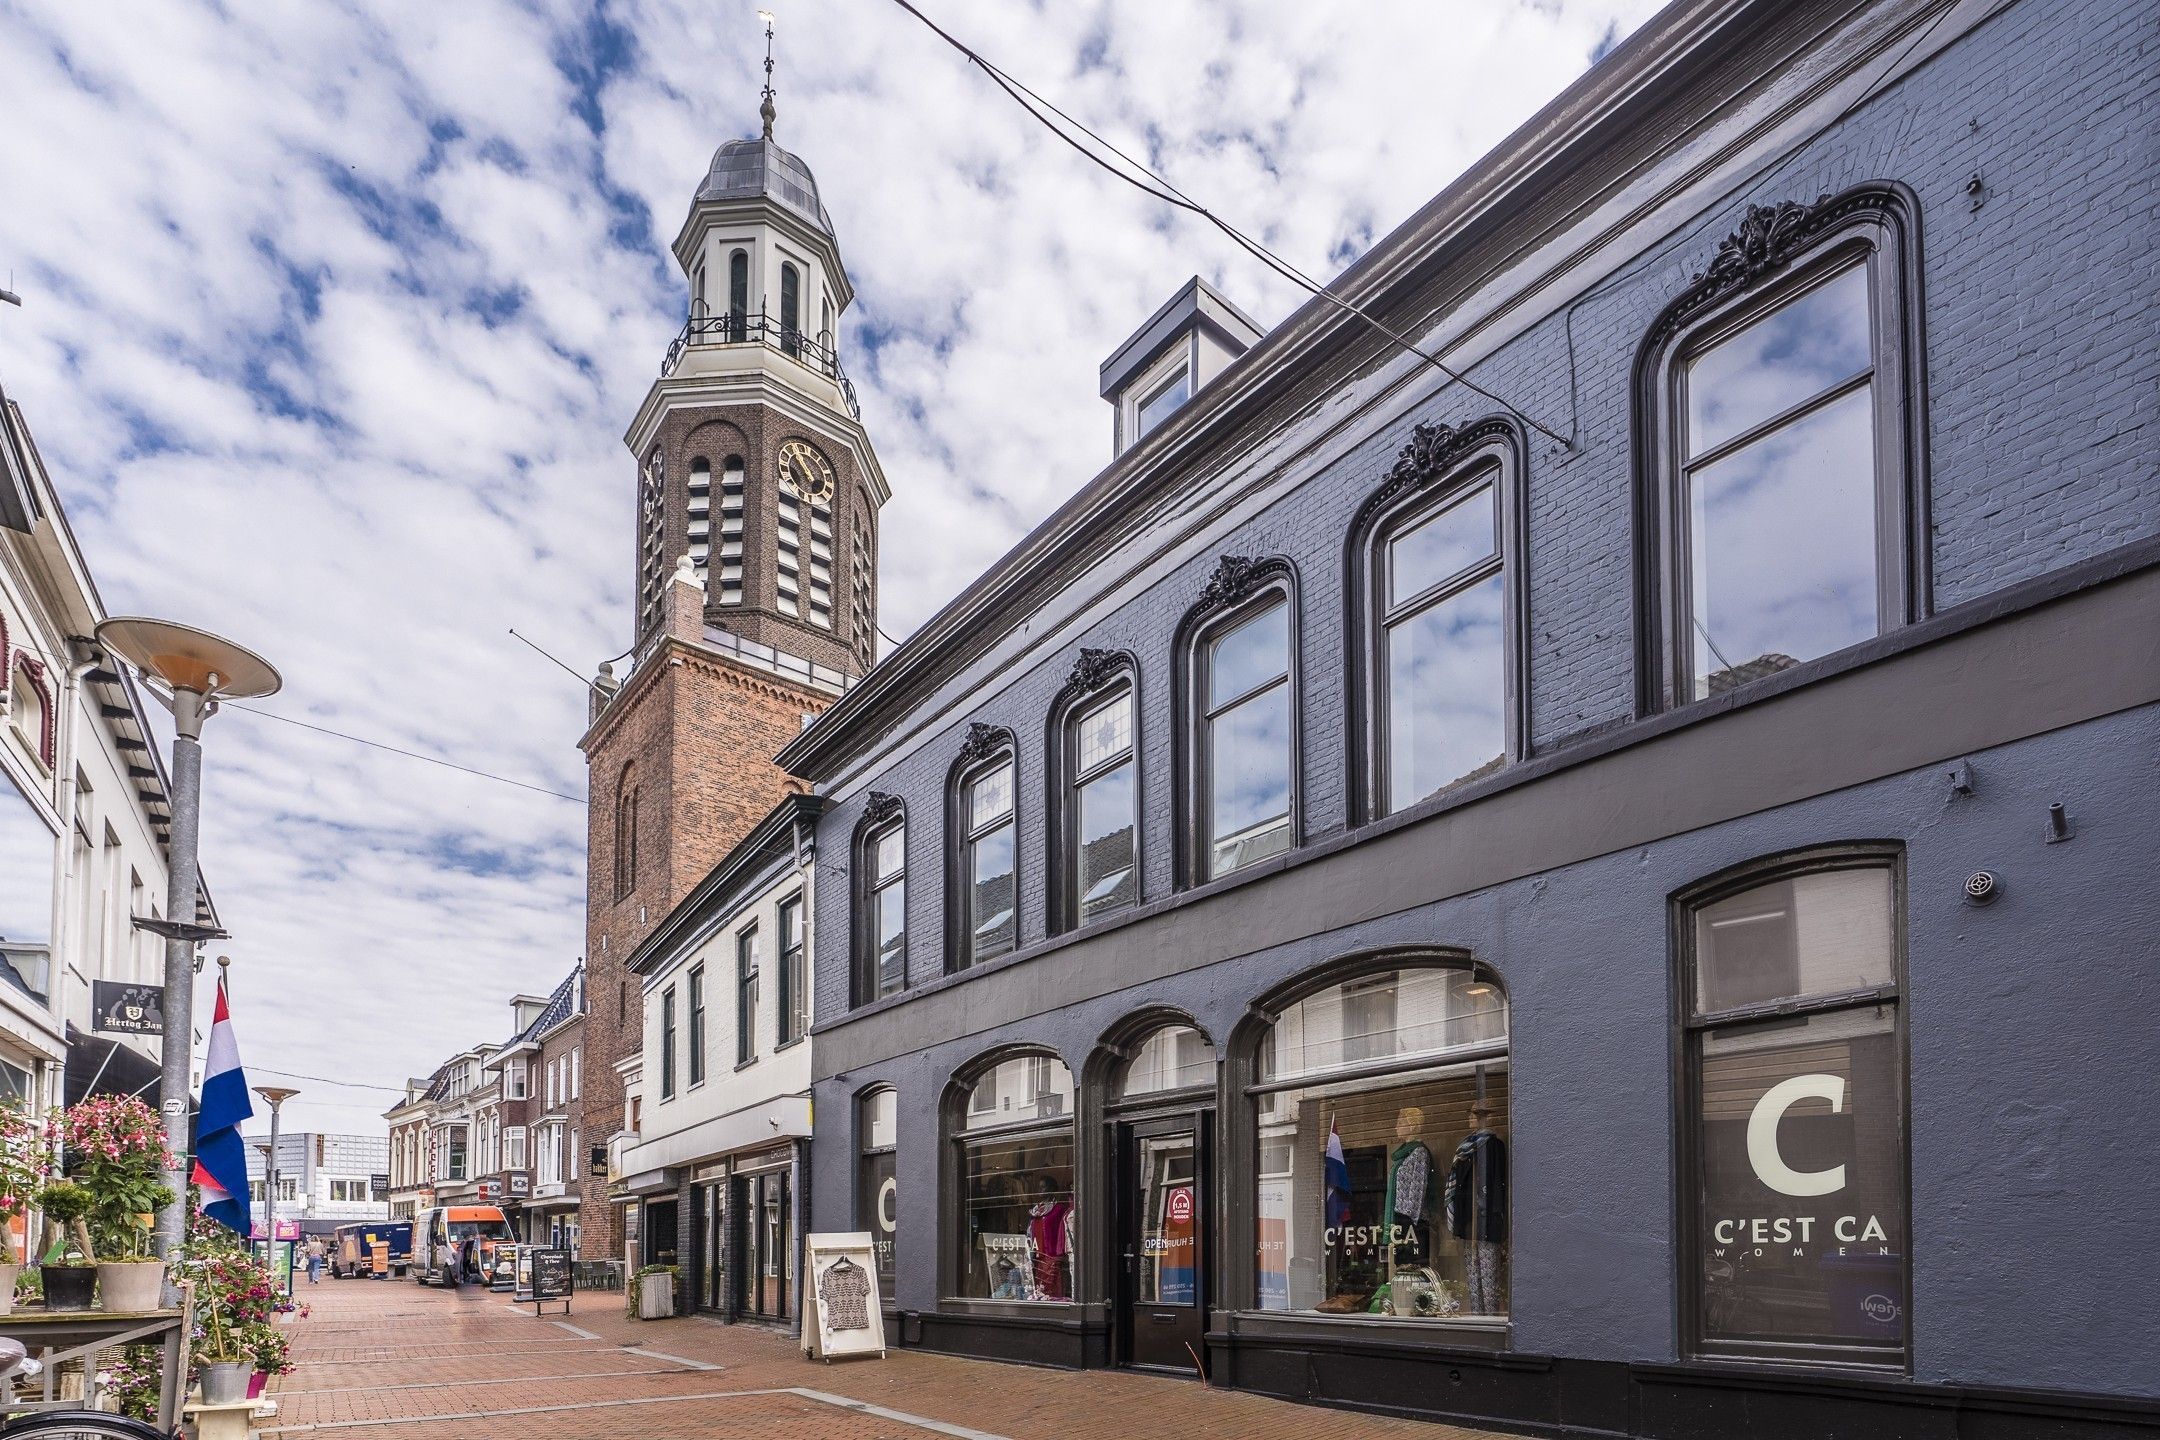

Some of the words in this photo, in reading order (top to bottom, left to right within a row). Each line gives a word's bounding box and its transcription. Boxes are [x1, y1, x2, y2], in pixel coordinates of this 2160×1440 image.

[105, 1017, 141, 1030] Hertog
[143, 1020, 162, 1030] Jan
[1746, 1073, 1846, 1197] C
[1324, 1225, 1382, 1246] C'EST
[1390, 1224, 1418, 1244] CA
[1714, 1217, 1815, 1244] C'EST
[1834, 1215, 1888, 1242] CA
[992, 1237, 1020, 1251] C'EST
[1145, 1239, 1168, 1249] OPEN
[1324, 1248, 1419, 1256] WOMEN
[1714, 1247, 1888, 1257] WOMEN
